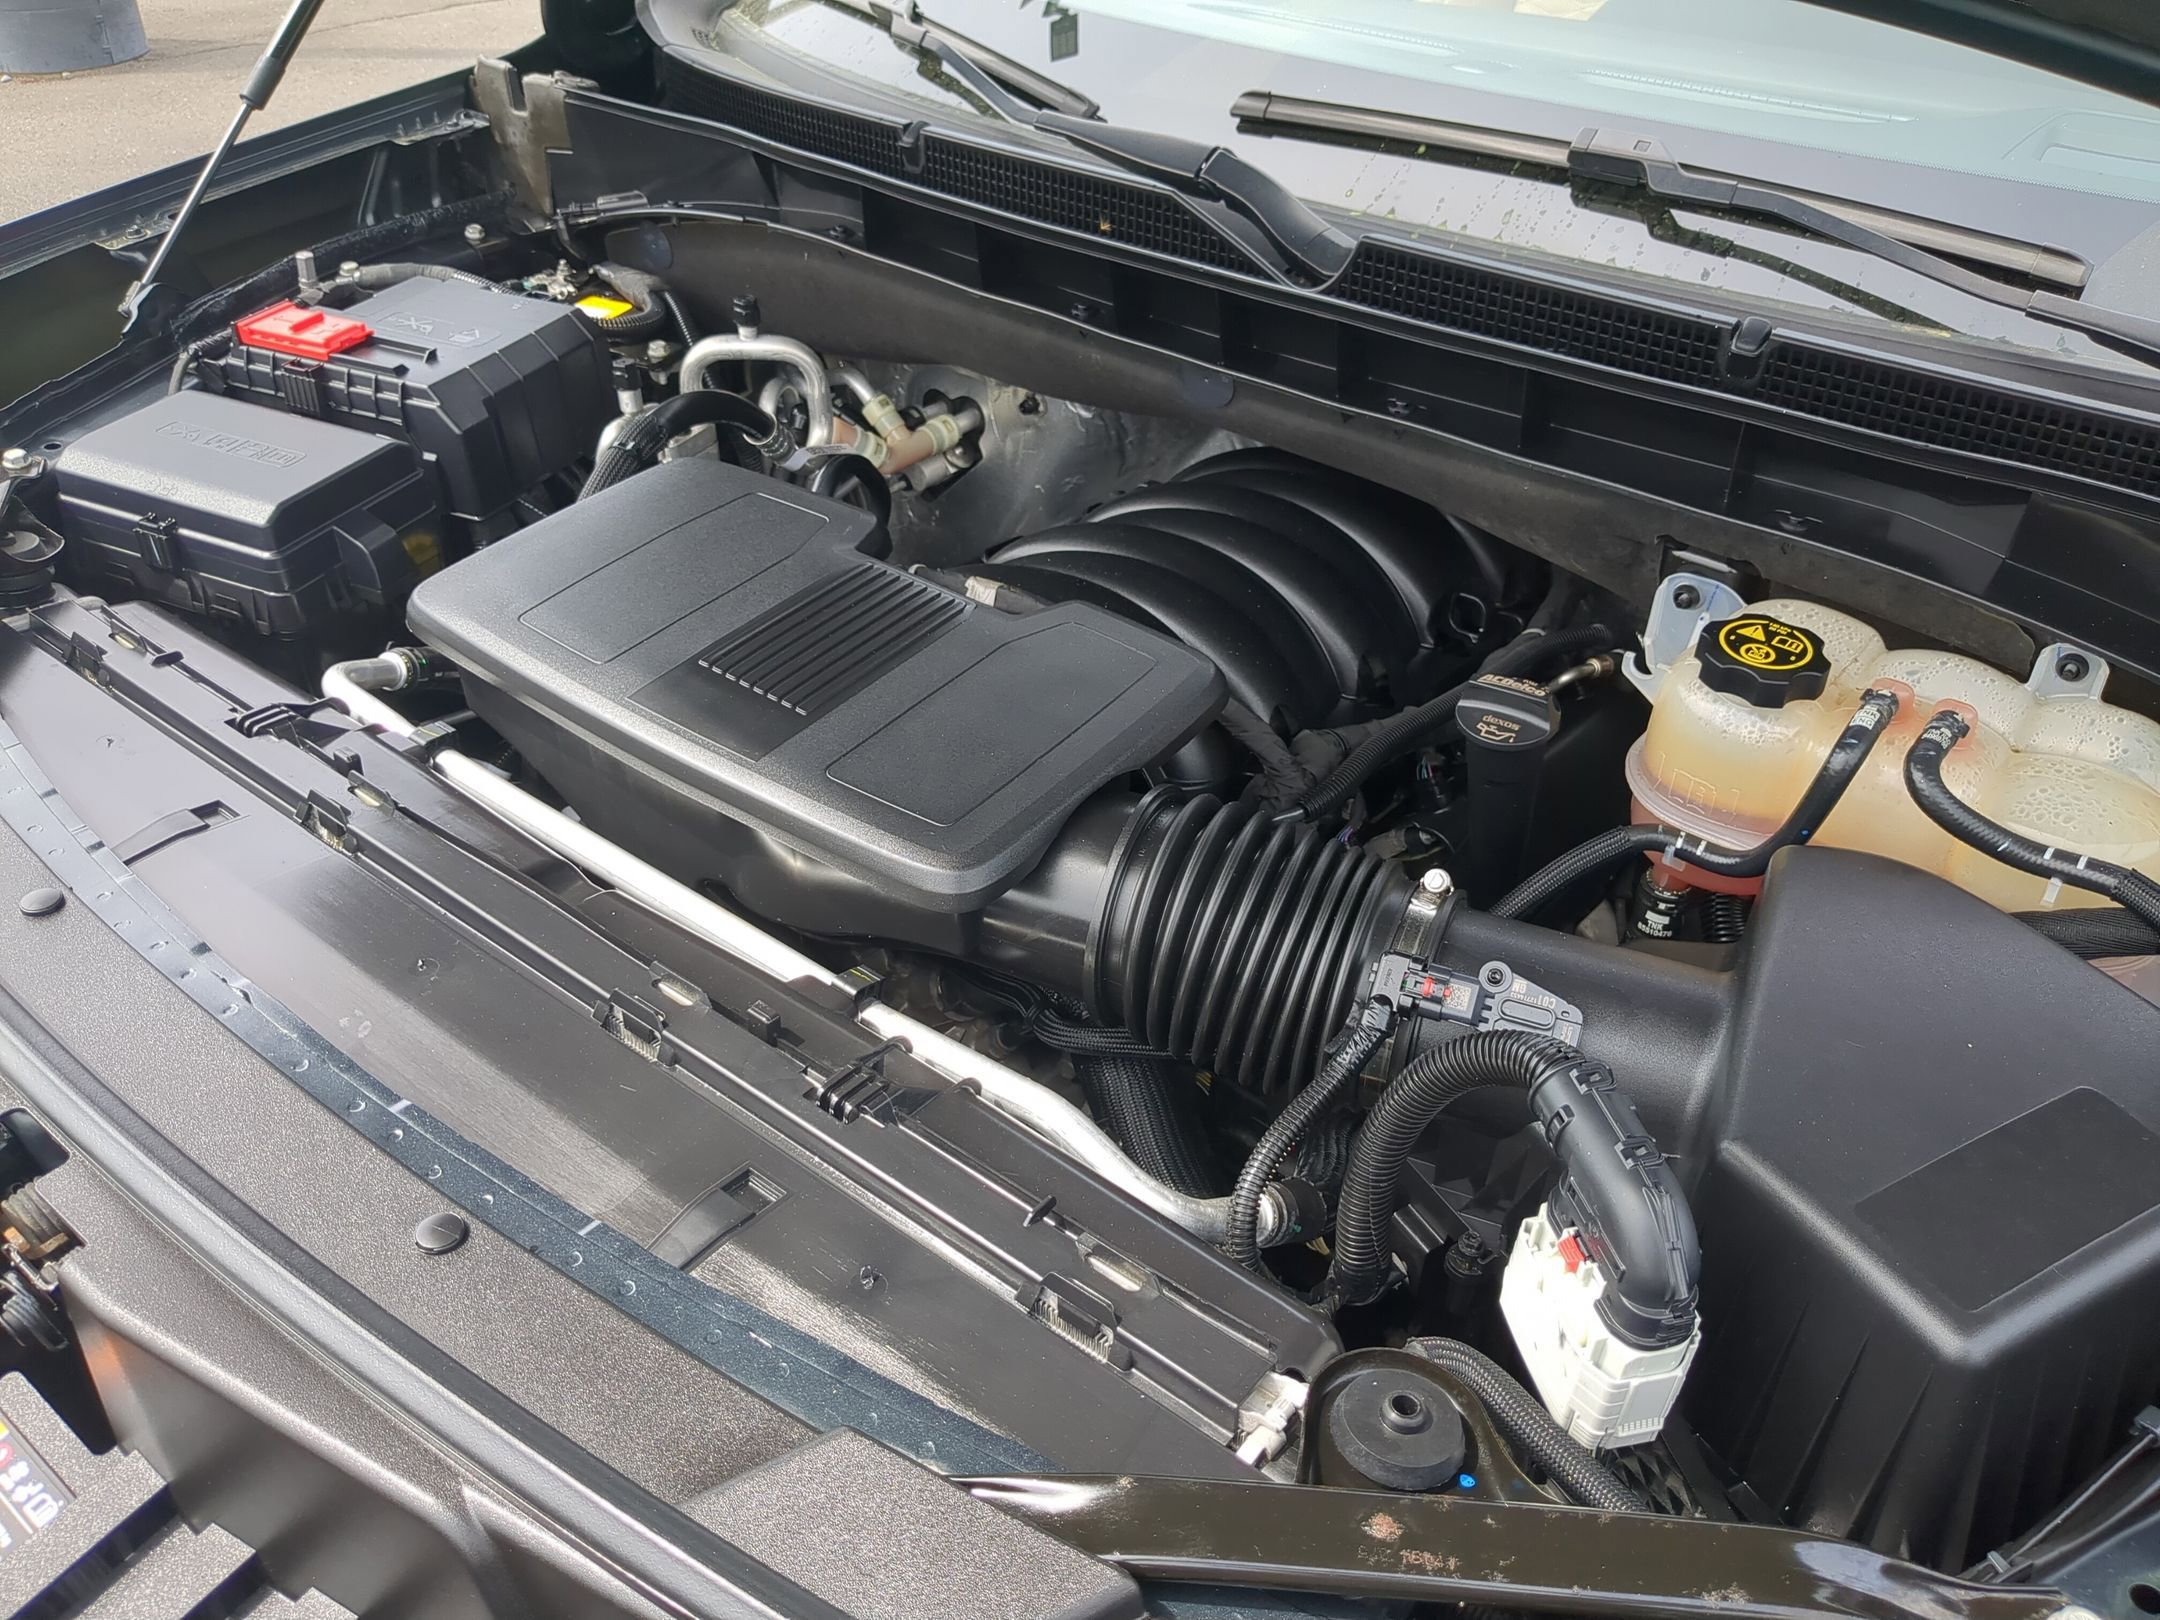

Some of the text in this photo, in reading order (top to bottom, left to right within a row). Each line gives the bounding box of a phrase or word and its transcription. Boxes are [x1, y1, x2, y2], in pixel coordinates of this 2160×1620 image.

[1477, 673, 1546, 697] ACDelco
[1482, 714, 1520, 731] dexos
[1647, 920, 1664, 931] TNK
[1511, 981, 1527, 994] GM
